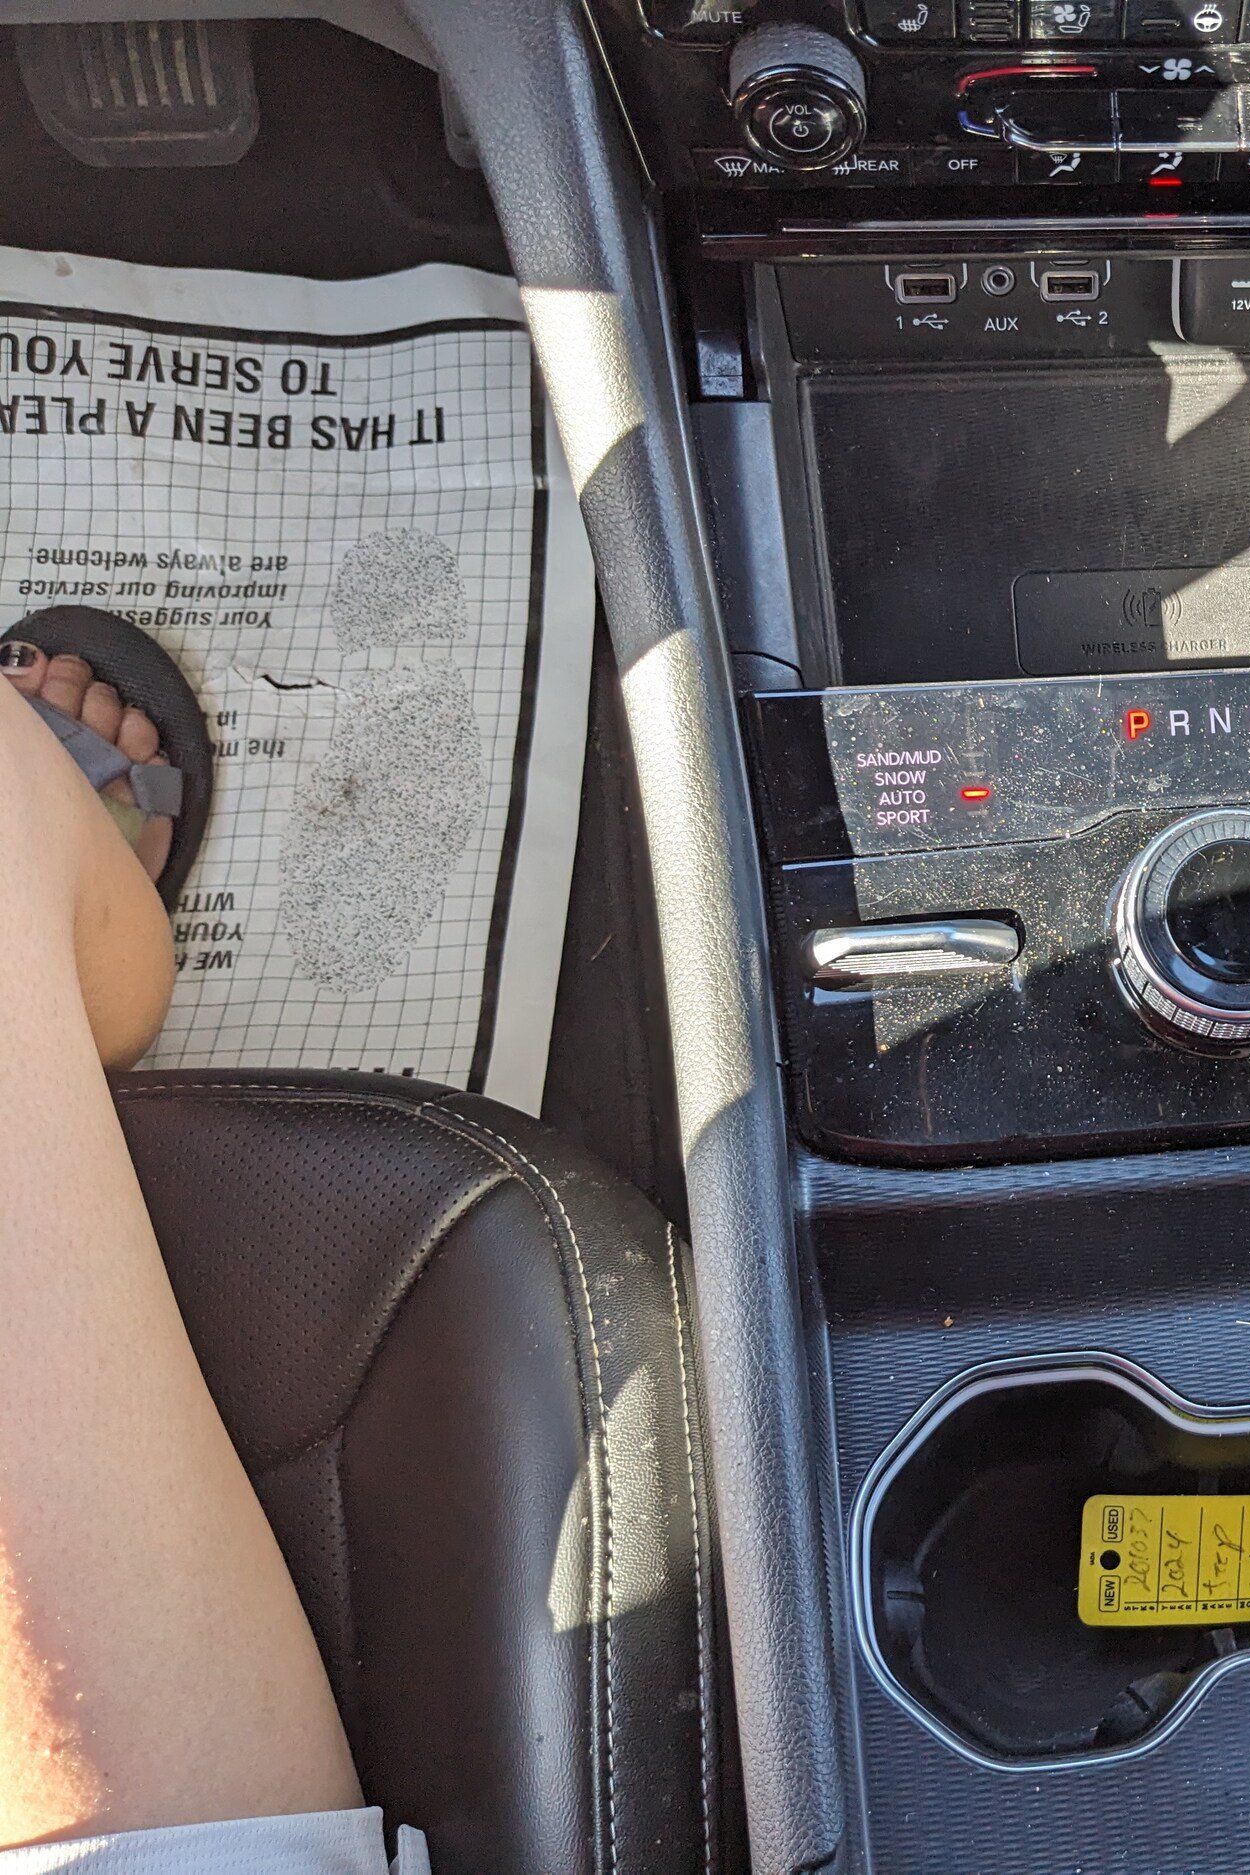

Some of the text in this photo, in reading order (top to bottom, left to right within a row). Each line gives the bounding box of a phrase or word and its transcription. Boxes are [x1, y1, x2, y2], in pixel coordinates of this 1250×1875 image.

[691, 11, 743, 24] MUTE
[785, 105, 812, 115] VOL
[754, 162, 785, 174] MA
[858, 159, 899, 172] REAR
[948, 158, 978, 171] OFF
[984, 316, 1019, 331] AUX
[1098, 311, 1109, 325] 2
[108, 341, 263, 395] SERVE
[281, 359, 337, 397] TO
[126, 400, 157, 438] A
[172, 404, 292, 450] BEEN
[408, 406, 445, 447] IT
[311, 414, 395, 452] HAS
[28, 548, 288, 576] are always welcome.
[19, 579, 288, 602] improving our service
[215, 610, 273, 629] Your
[1081, 638, 1228, 655] WIRELESS CHARGER
[217, 711, 237, 730] in
[1127, 709, 1150, 740] P
[1170, 709, 1191, 737] R
[1209, 707, 1232, 734] N
[248, 740, 286, 759] the
[857, 750, 942, 768] SAND/MUD
[874, 771, 926, 787] SNOW
[879, 790, 927, 806] AUTO
[876, 809, 930, 827] SPORT
[174, 921, 243, 942] YOUR
[193, 950, 233, 971] WE
[1107, 1508, 1119, 1540] USED
[1161, 1530, 1193, 1598] 2024
[1104, 1580, 1115, 1606] NEW
[1161, 1603, 1192, 1611] YEAR
[1202, 1602, 1232, 1610] MAKE
